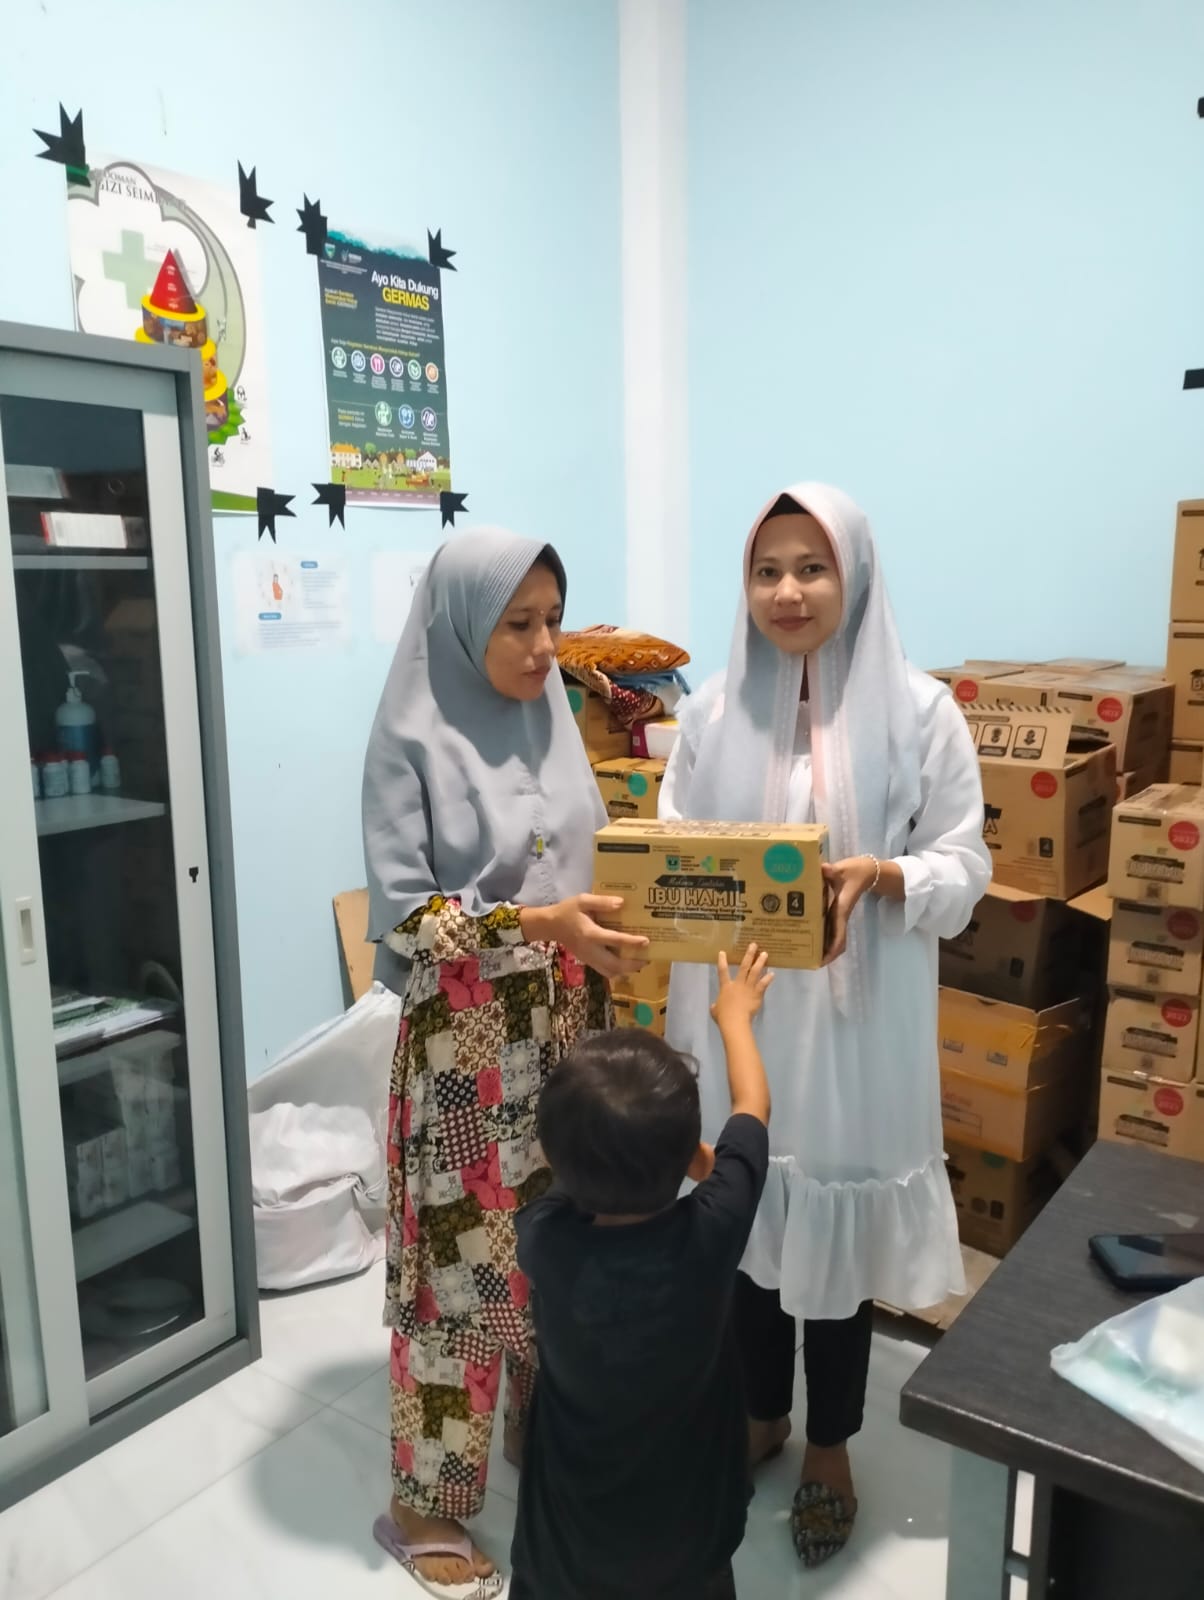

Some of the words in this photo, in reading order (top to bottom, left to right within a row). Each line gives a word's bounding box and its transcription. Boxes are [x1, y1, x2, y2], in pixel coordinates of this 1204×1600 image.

[371, 270, 389, 287] Ayo
[390, 274, 407, 291] Kita
[408, 279, 439, 300] Dukung
[383, 287, 430, 311] GERMAS
[648, 887, 681, 906] IBU
[684, 888, 748, 908] HAMIL
[790, 898, 801, 909] 4
